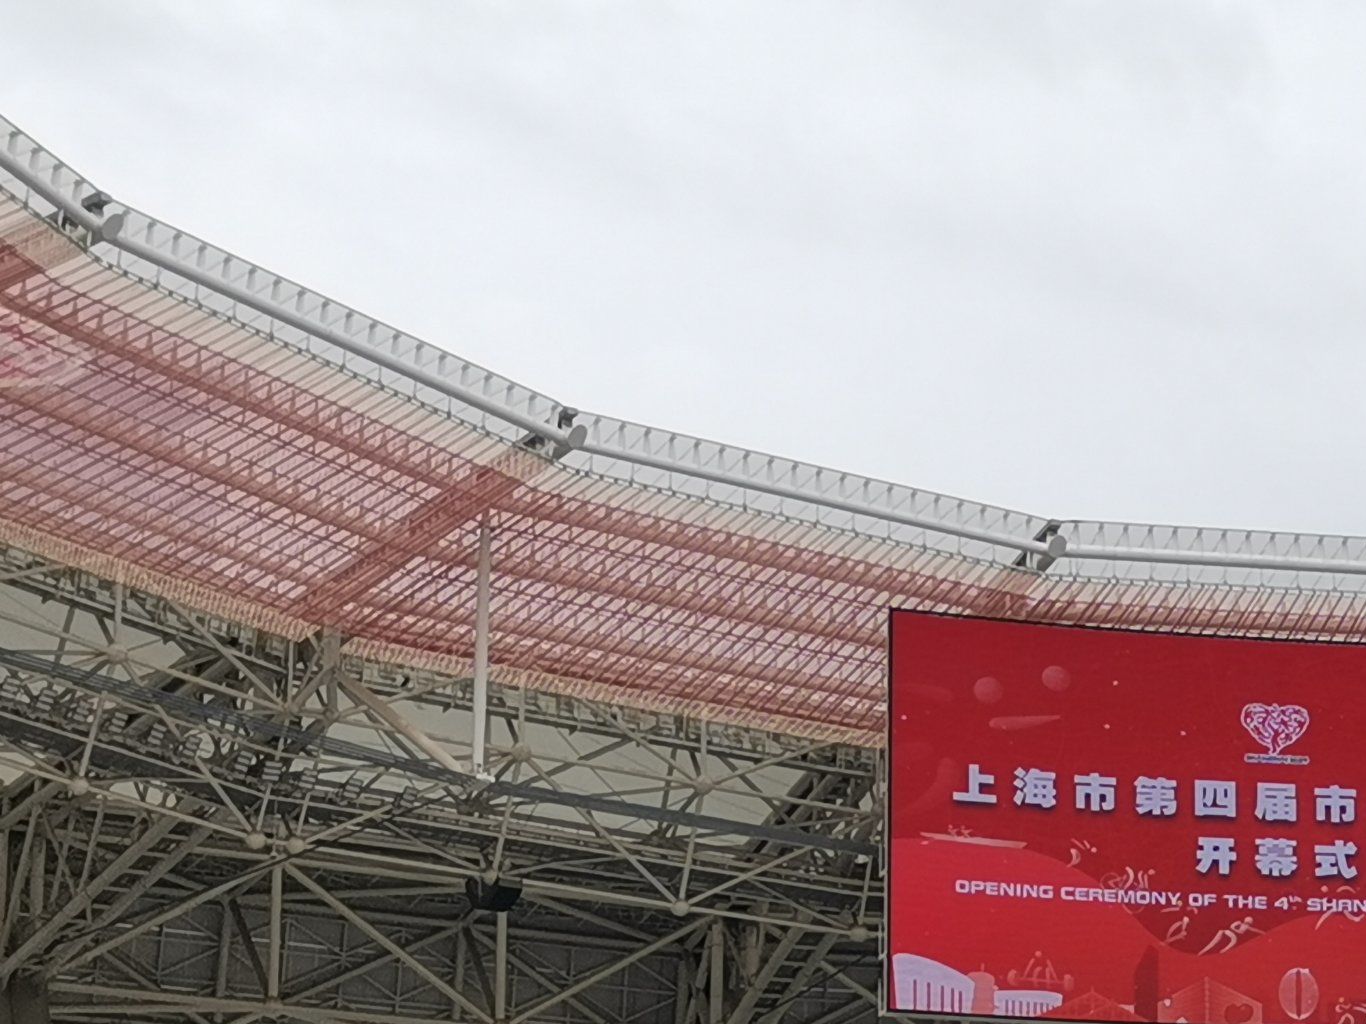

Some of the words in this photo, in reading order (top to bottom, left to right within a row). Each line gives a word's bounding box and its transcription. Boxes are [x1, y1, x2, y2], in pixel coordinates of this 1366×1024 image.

[1196, 836, 1358, 879] 开幕式
[955, 879, 1054, 899] OPENING
[1060, 886, 1181, 905] CEREMONY
[1188, 893, 1217, 907] OF
[1223, 893, 1268, 910] THE
